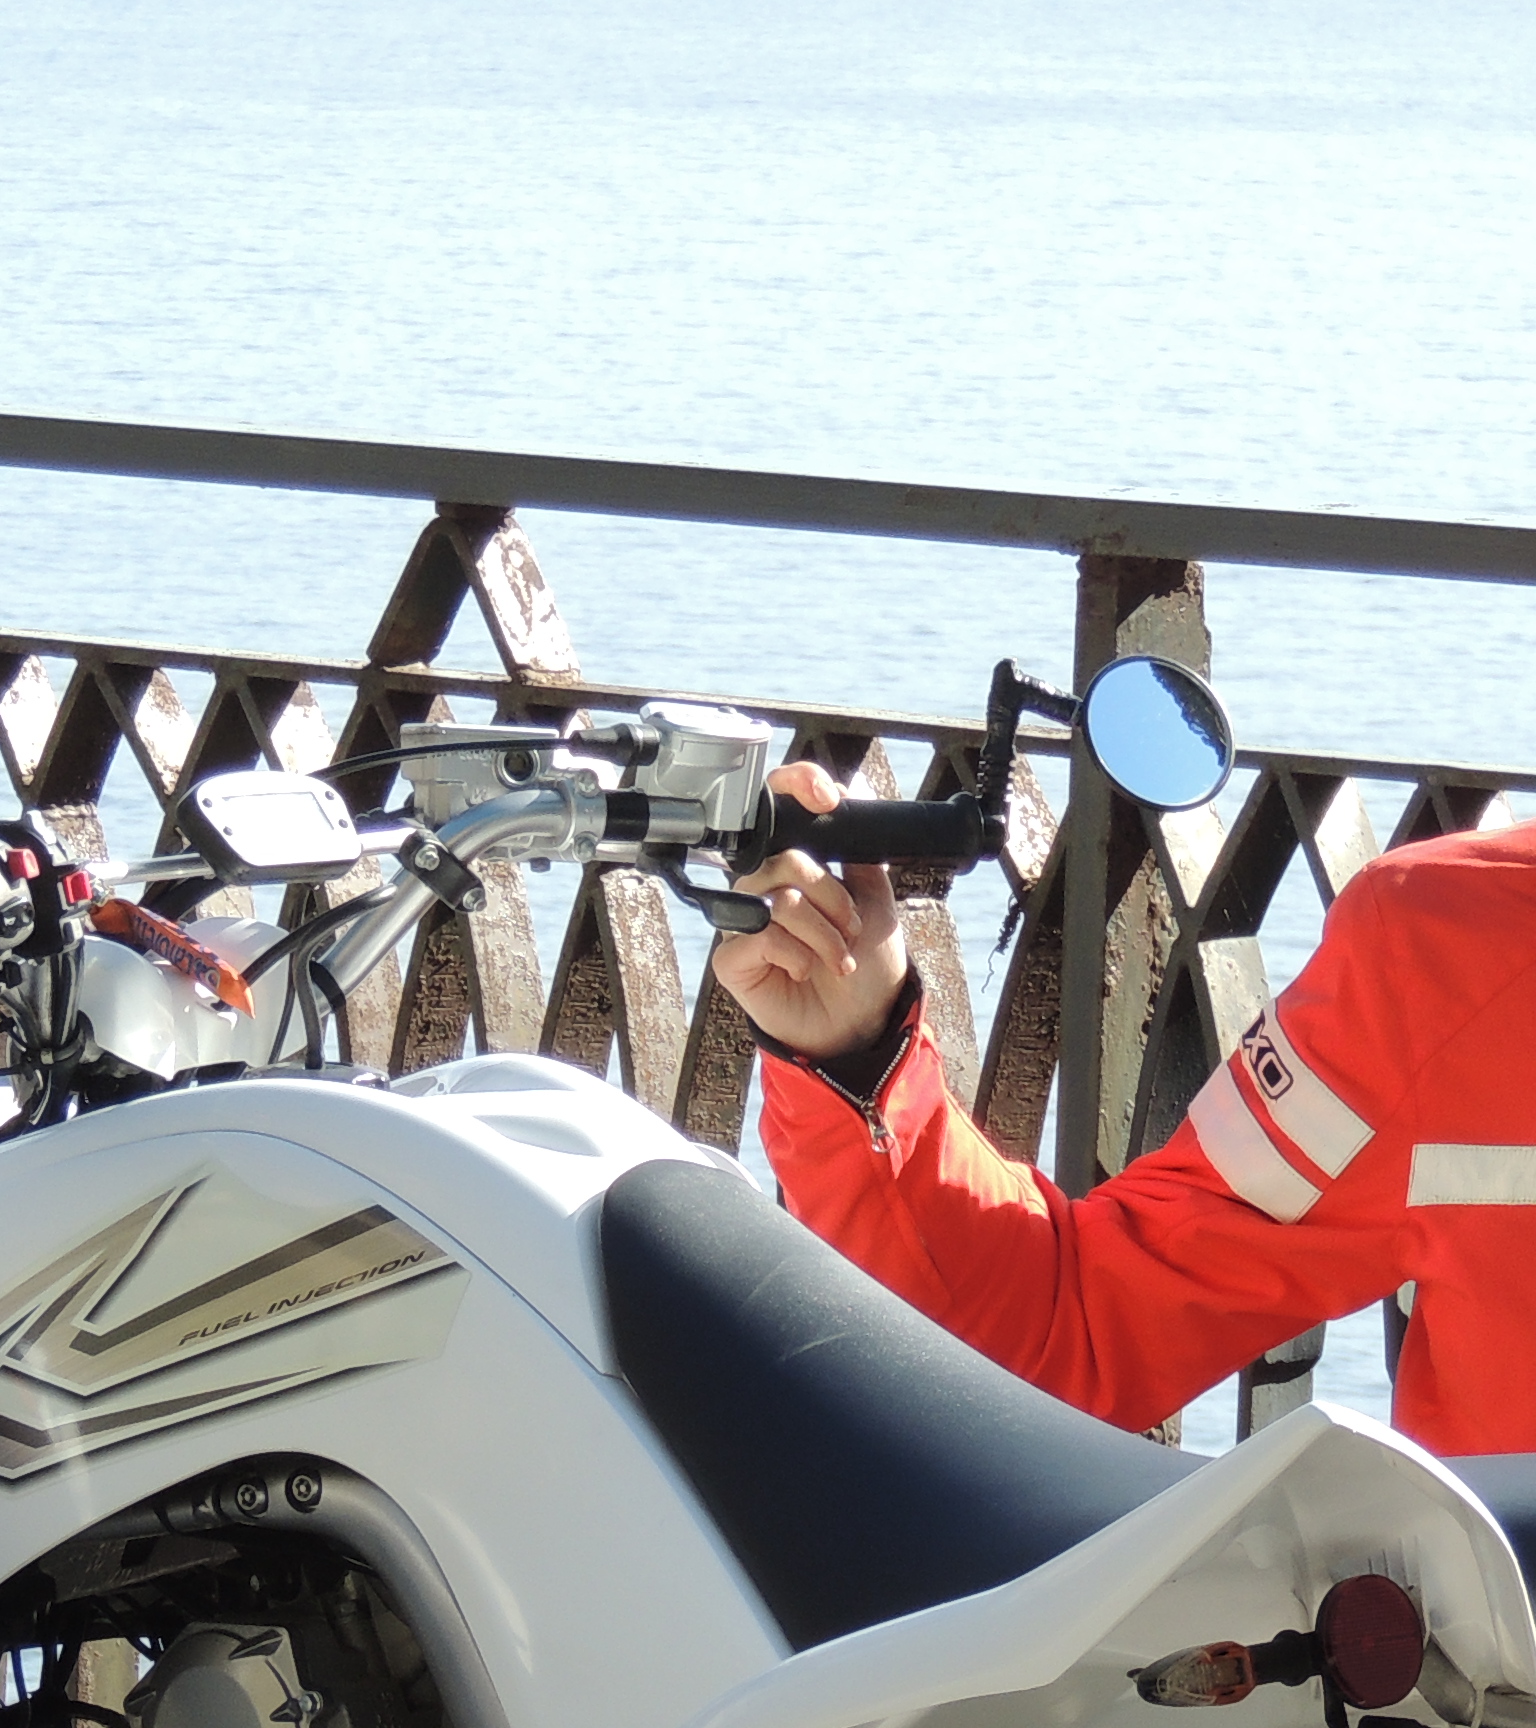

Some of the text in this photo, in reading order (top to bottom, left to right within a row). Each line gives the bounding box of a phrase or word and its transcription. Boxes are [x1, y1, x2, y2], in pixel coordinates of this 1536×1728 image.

[1242, 1008, 1294, 1101] XO
[178, 1250, 427, 1346] FUEL INJECTION
